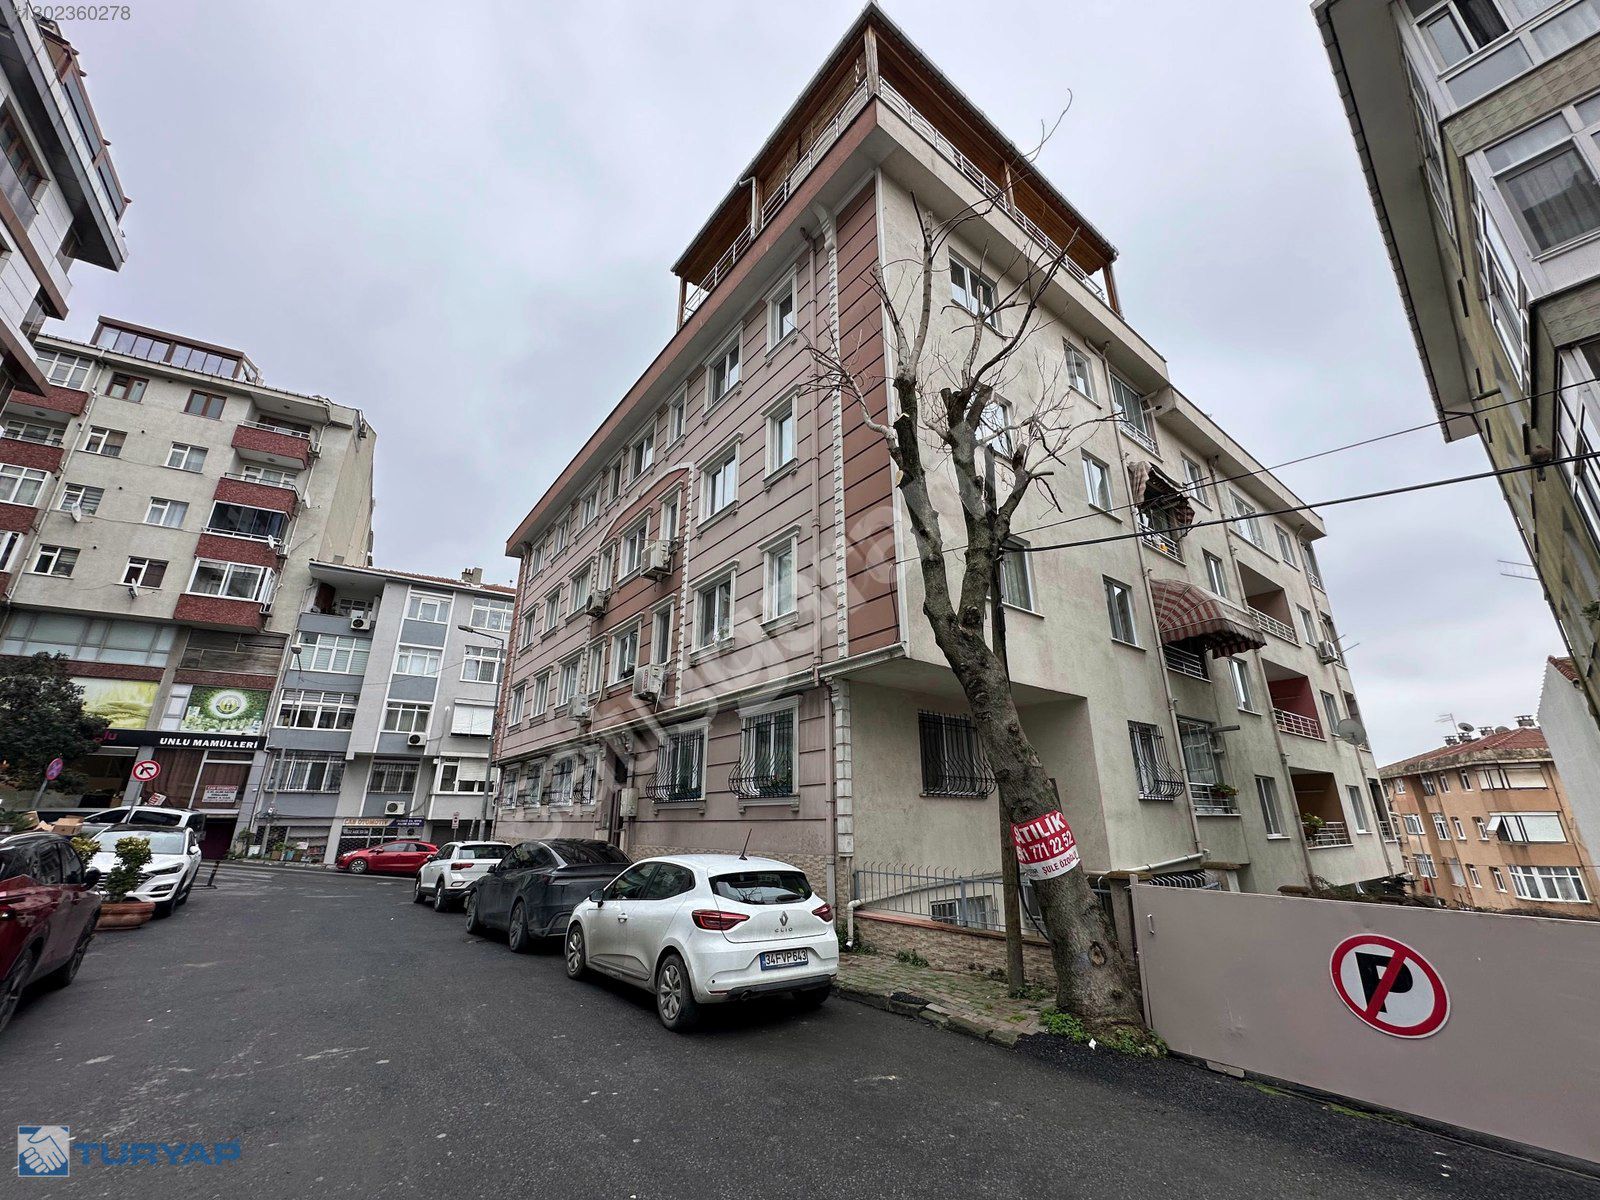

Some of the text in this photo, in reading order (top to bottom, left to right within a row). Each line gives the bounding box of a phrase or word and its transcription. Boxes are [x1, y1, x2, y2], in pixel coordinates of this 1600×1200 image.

[159, 738, 190, 746] UNLU
[1029, 842, 1050, 860] 771
[1049, 836, 1064, 855] 22
[1062, 830, 1074, 848] 52
[1041, 862, 1060, 876] ŞULE
